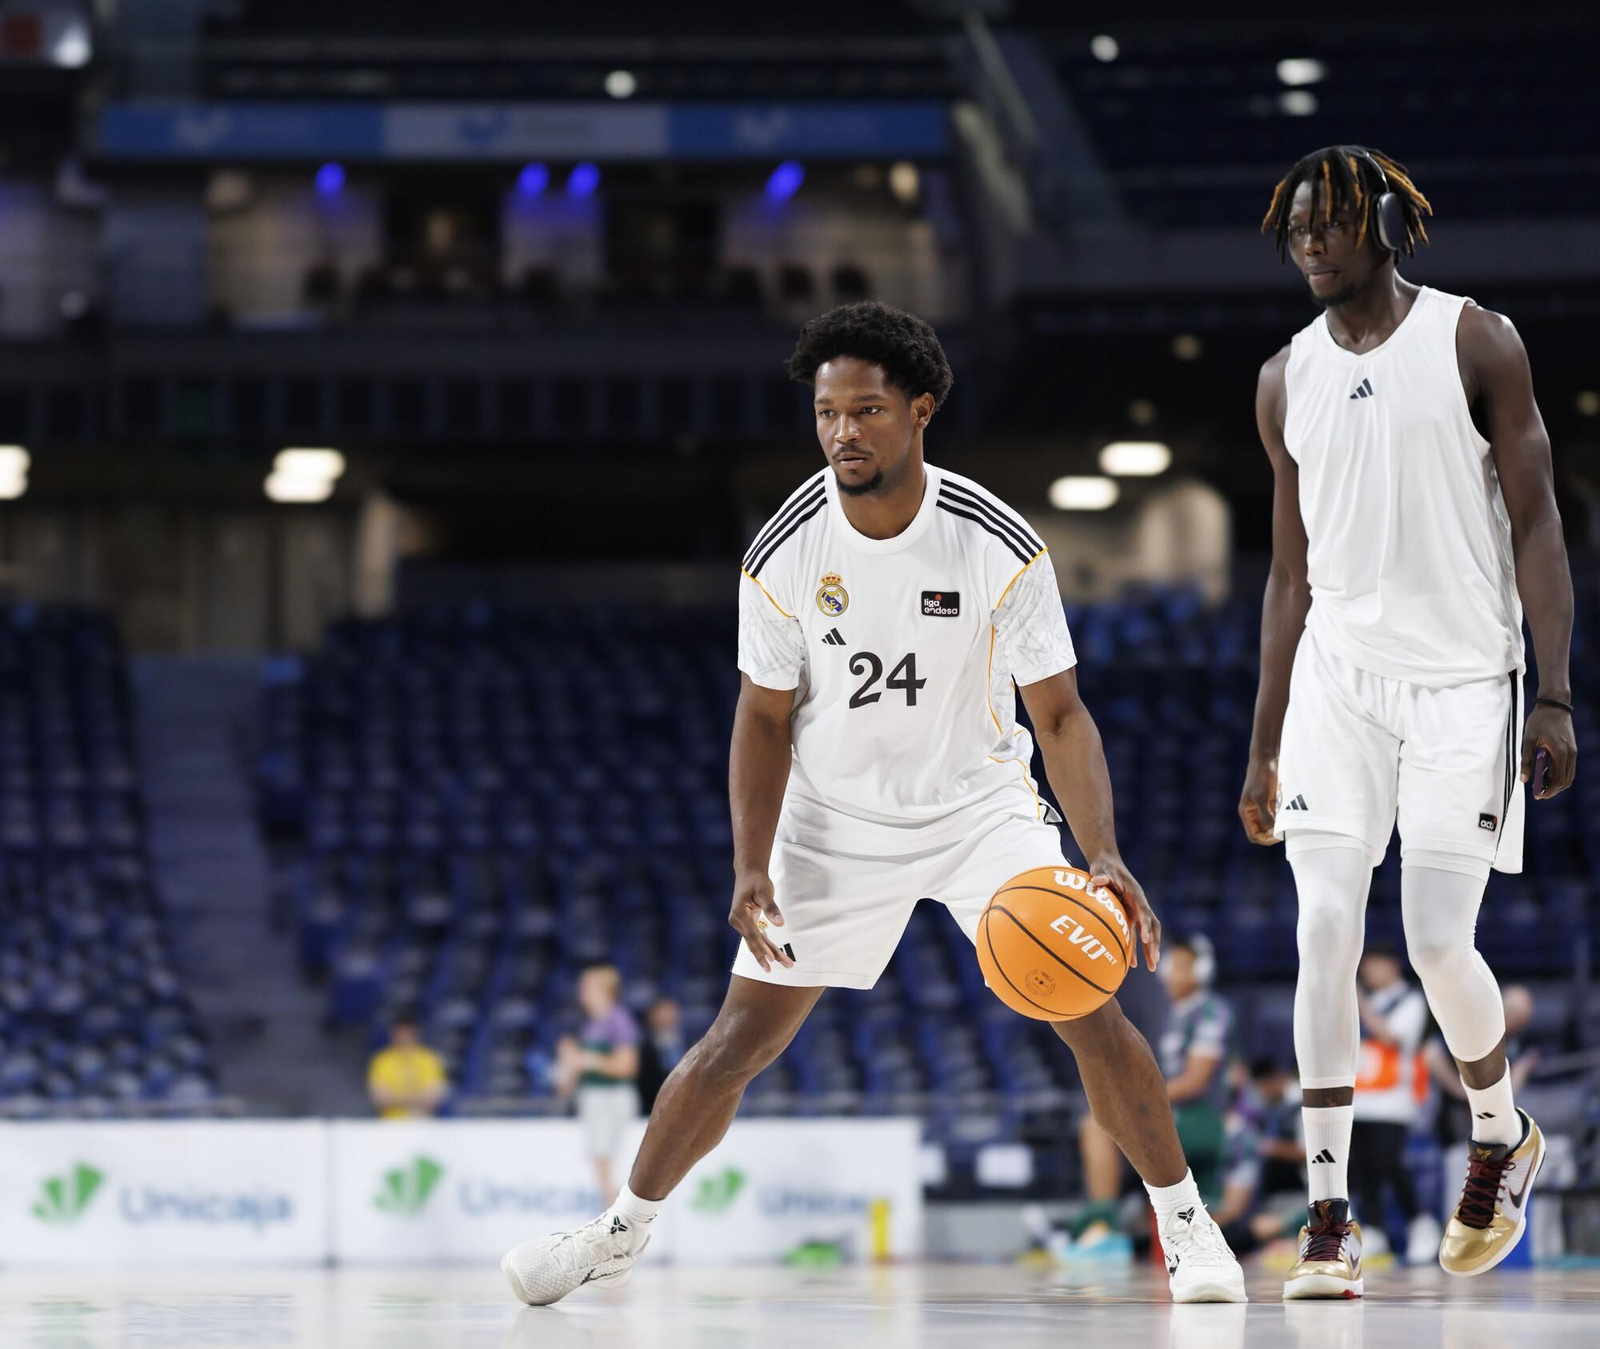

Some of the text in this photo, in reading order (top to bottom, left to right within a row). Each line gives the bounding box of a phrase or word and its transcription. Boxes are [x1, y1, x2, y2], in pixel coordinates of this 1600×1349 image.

[924, 598, 940, 607] liga
[924, 607, 958, 615] endesa
[849, 652, 927, 709] 24
[1480, 819, 1494, 830] acb
[1050, 914, 1107, 960] EVO
[118, 1184, 292, 1232] Unicaja
